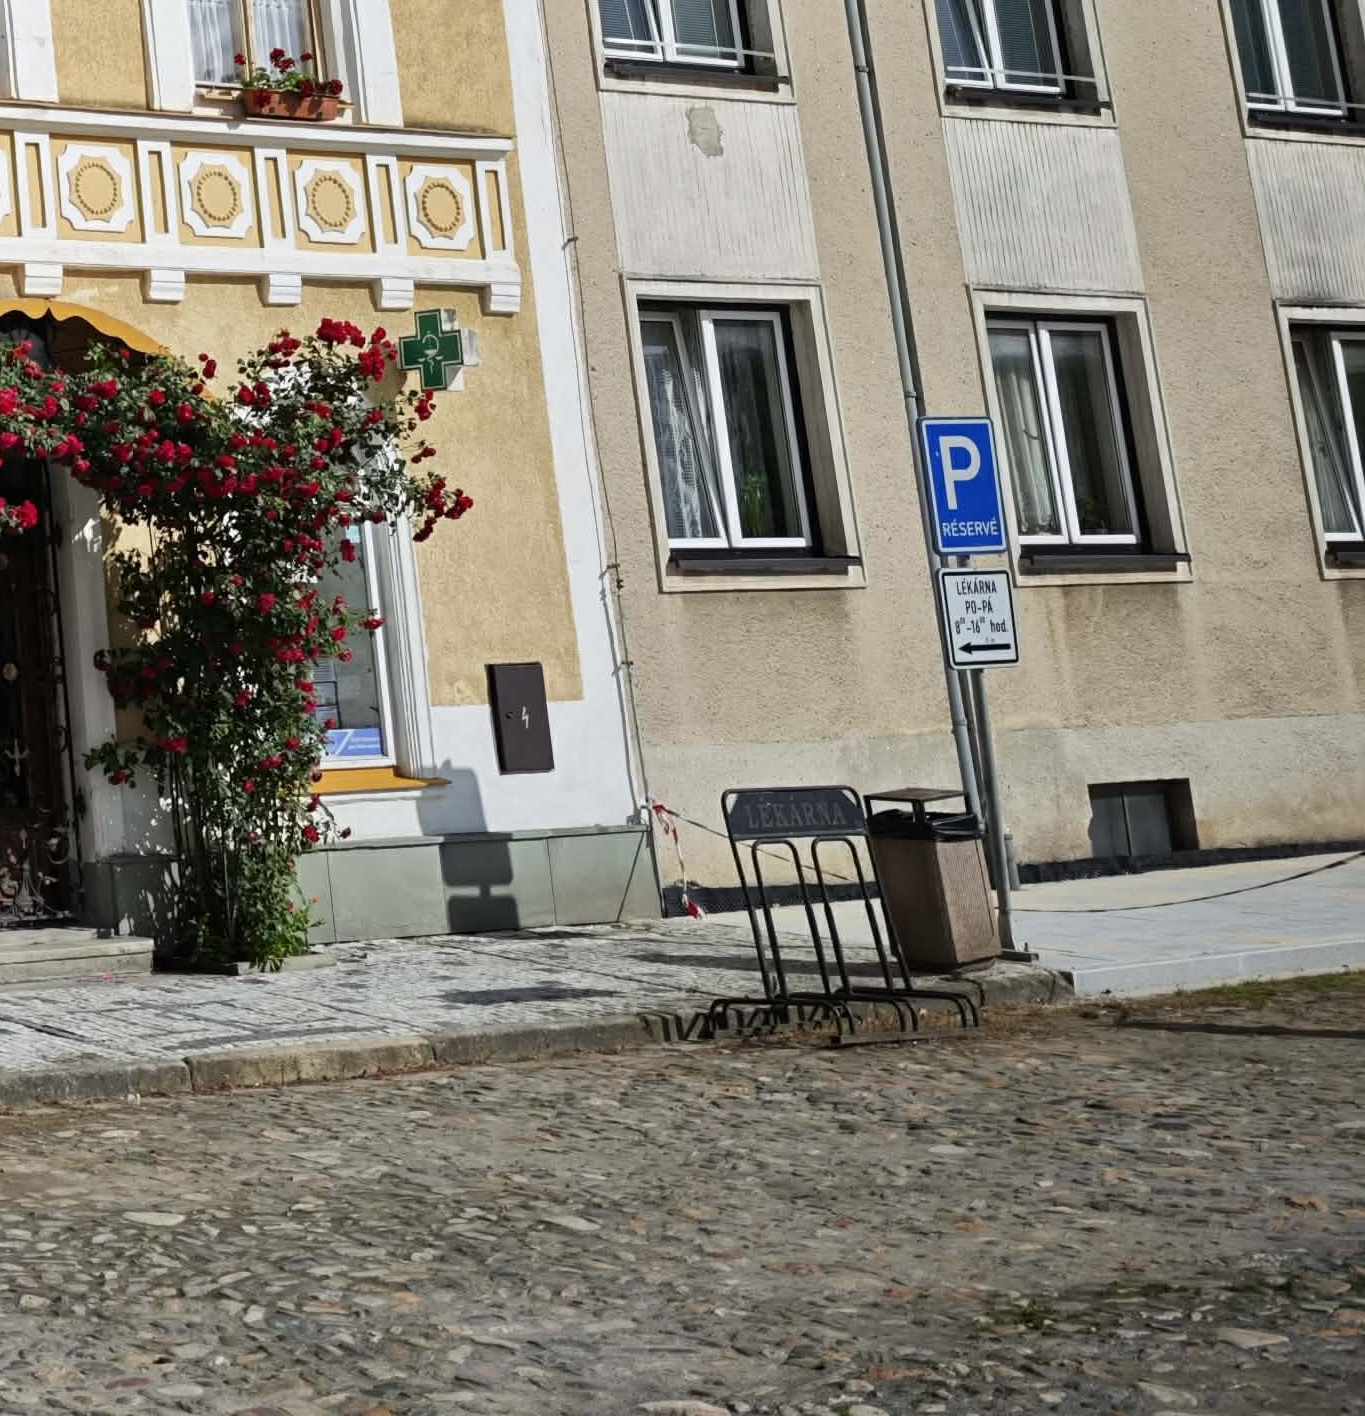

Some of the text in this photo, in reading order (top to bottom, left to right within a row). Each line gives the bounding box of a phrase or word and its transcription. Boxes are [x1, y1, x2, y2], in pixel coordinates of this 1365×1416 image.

[939, 436, 981, 510] P
[942, 516, 1000, 537] RÉSERVÉ
[956, 577, 998, 595] LÉKÁRNA
[965, 596, 994, 614] PO-PÁ
[990, 619, 1009, 633] hod.
